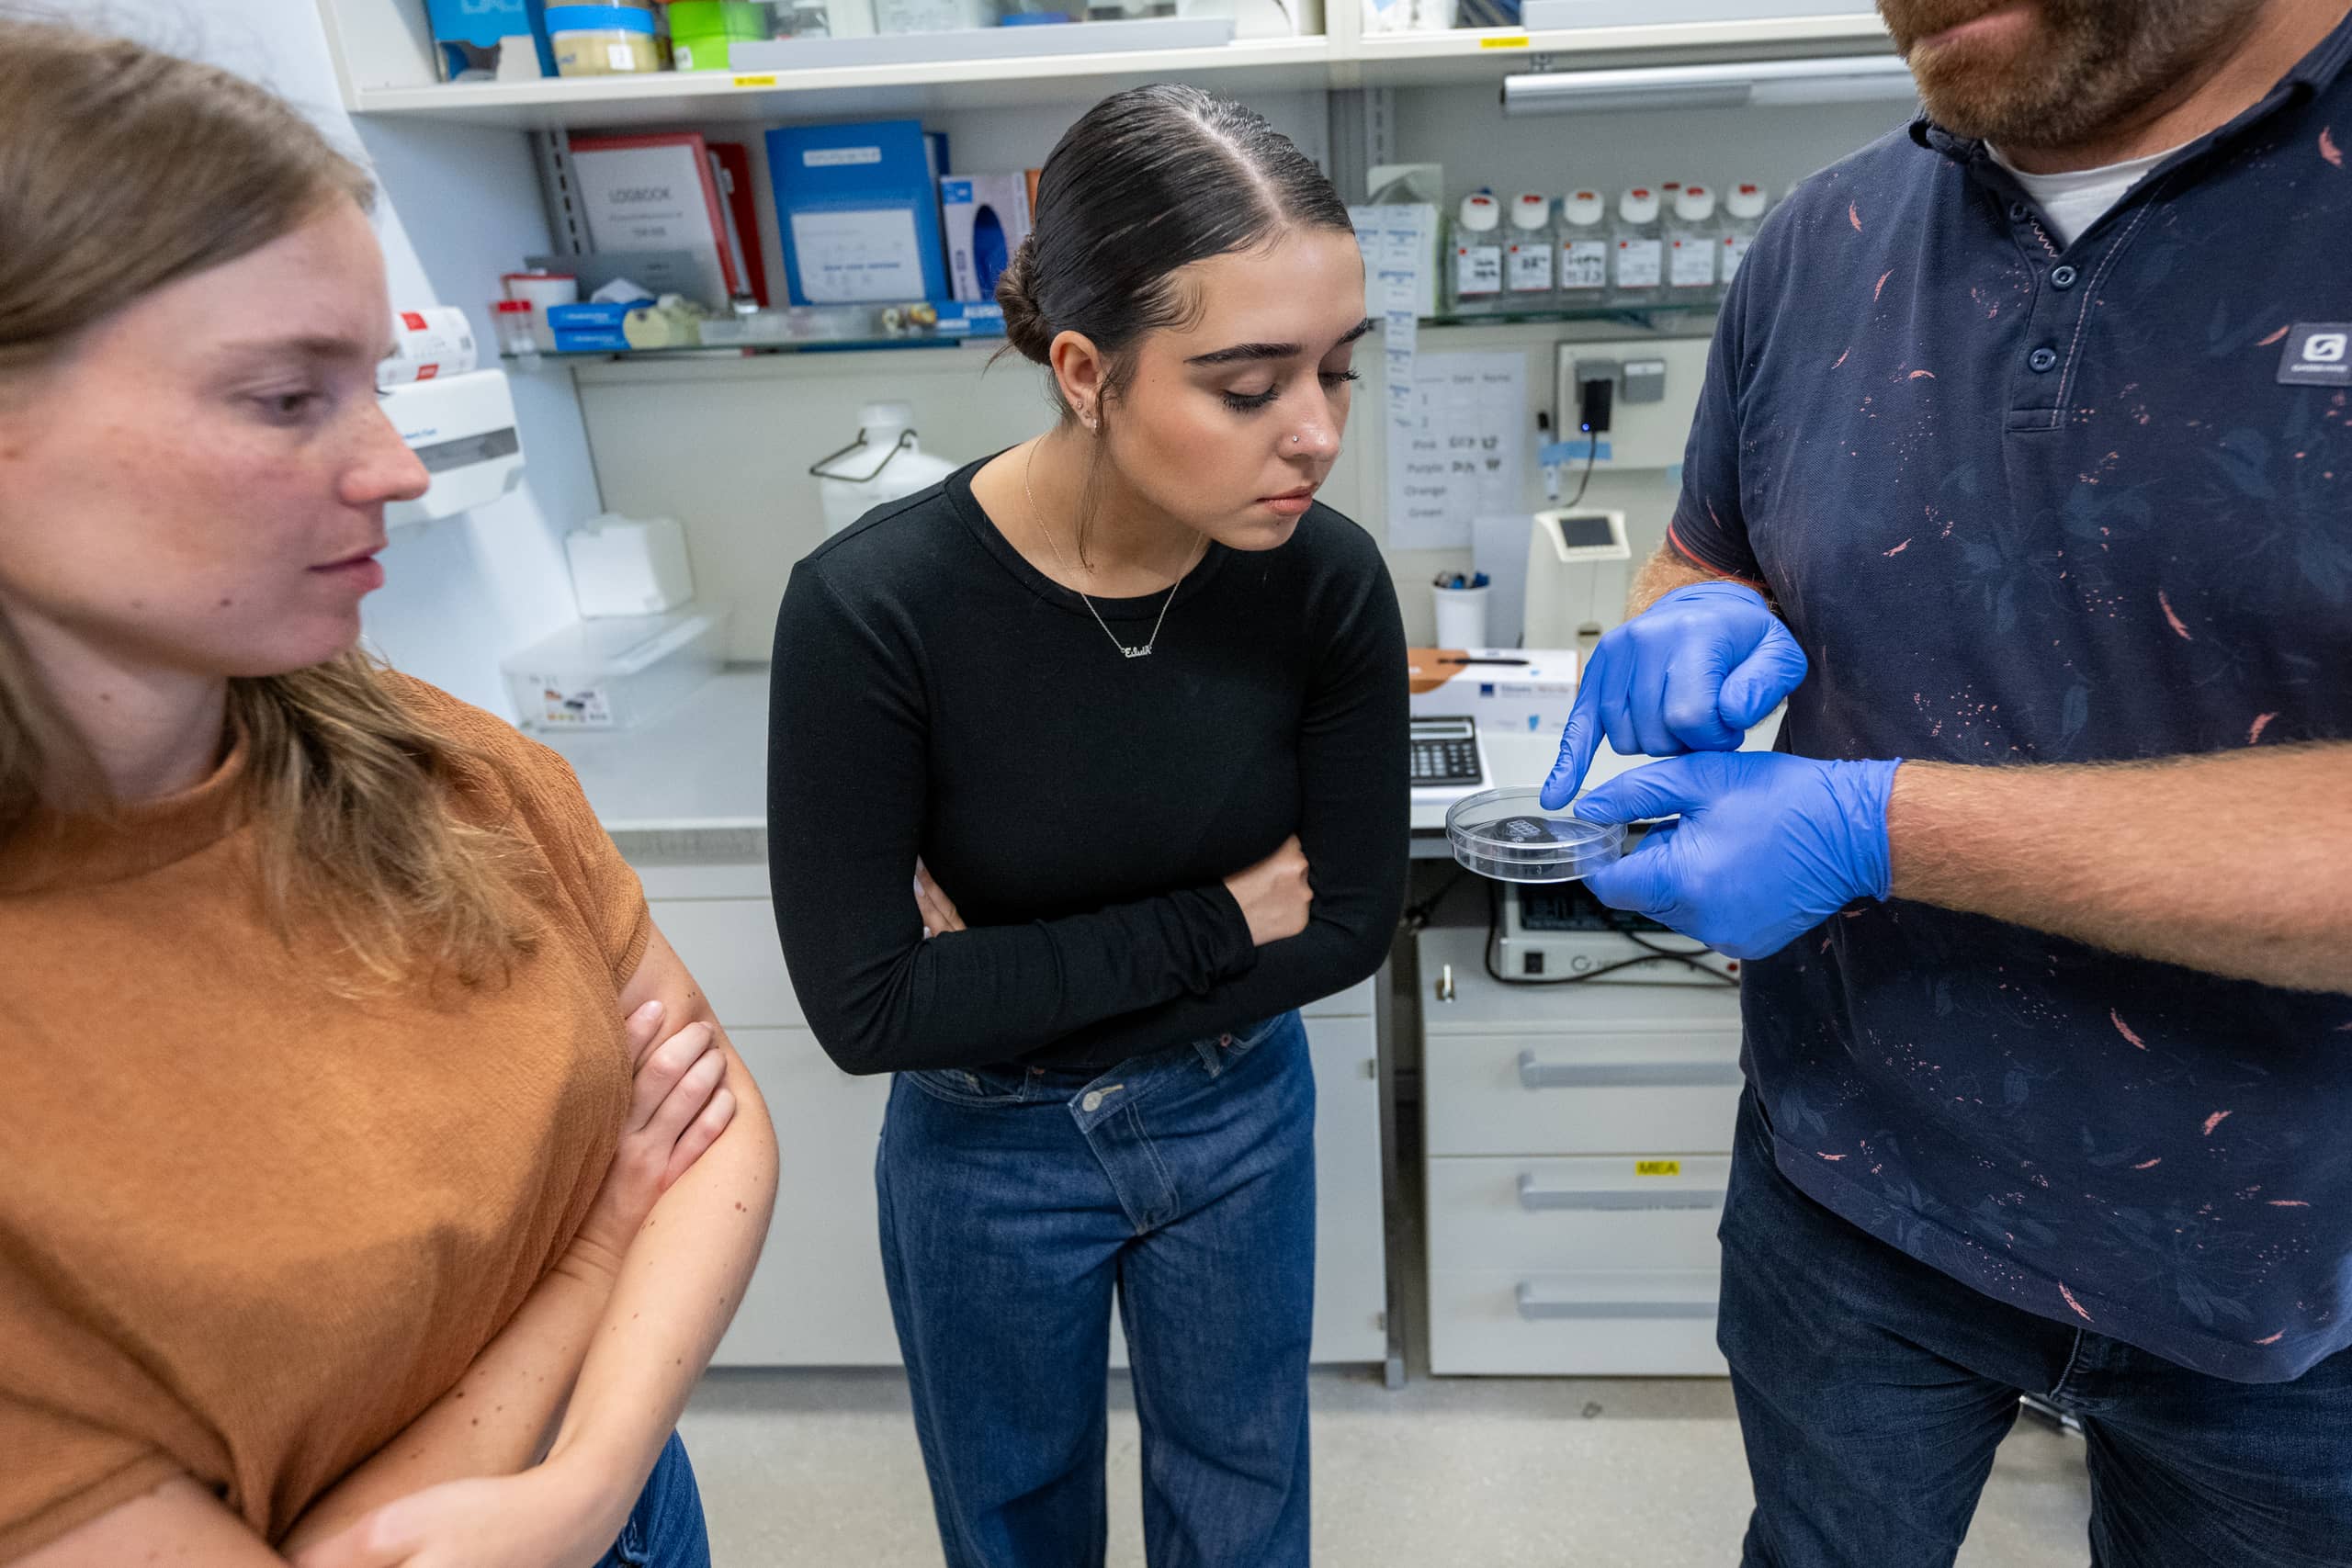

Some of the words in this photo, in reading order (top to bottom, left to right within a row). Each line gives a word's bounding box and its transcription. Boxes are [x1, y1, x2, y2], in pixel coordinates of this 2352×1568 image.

[608, 186, 672, 203] LOGBOOK
[1412, 439, 1437, 450] Pink
[1407, 463, 1444, 475] Purple
[1404, 485, 1447, 499] Orange
[1638, 1161, 1678, 1175] MEA
